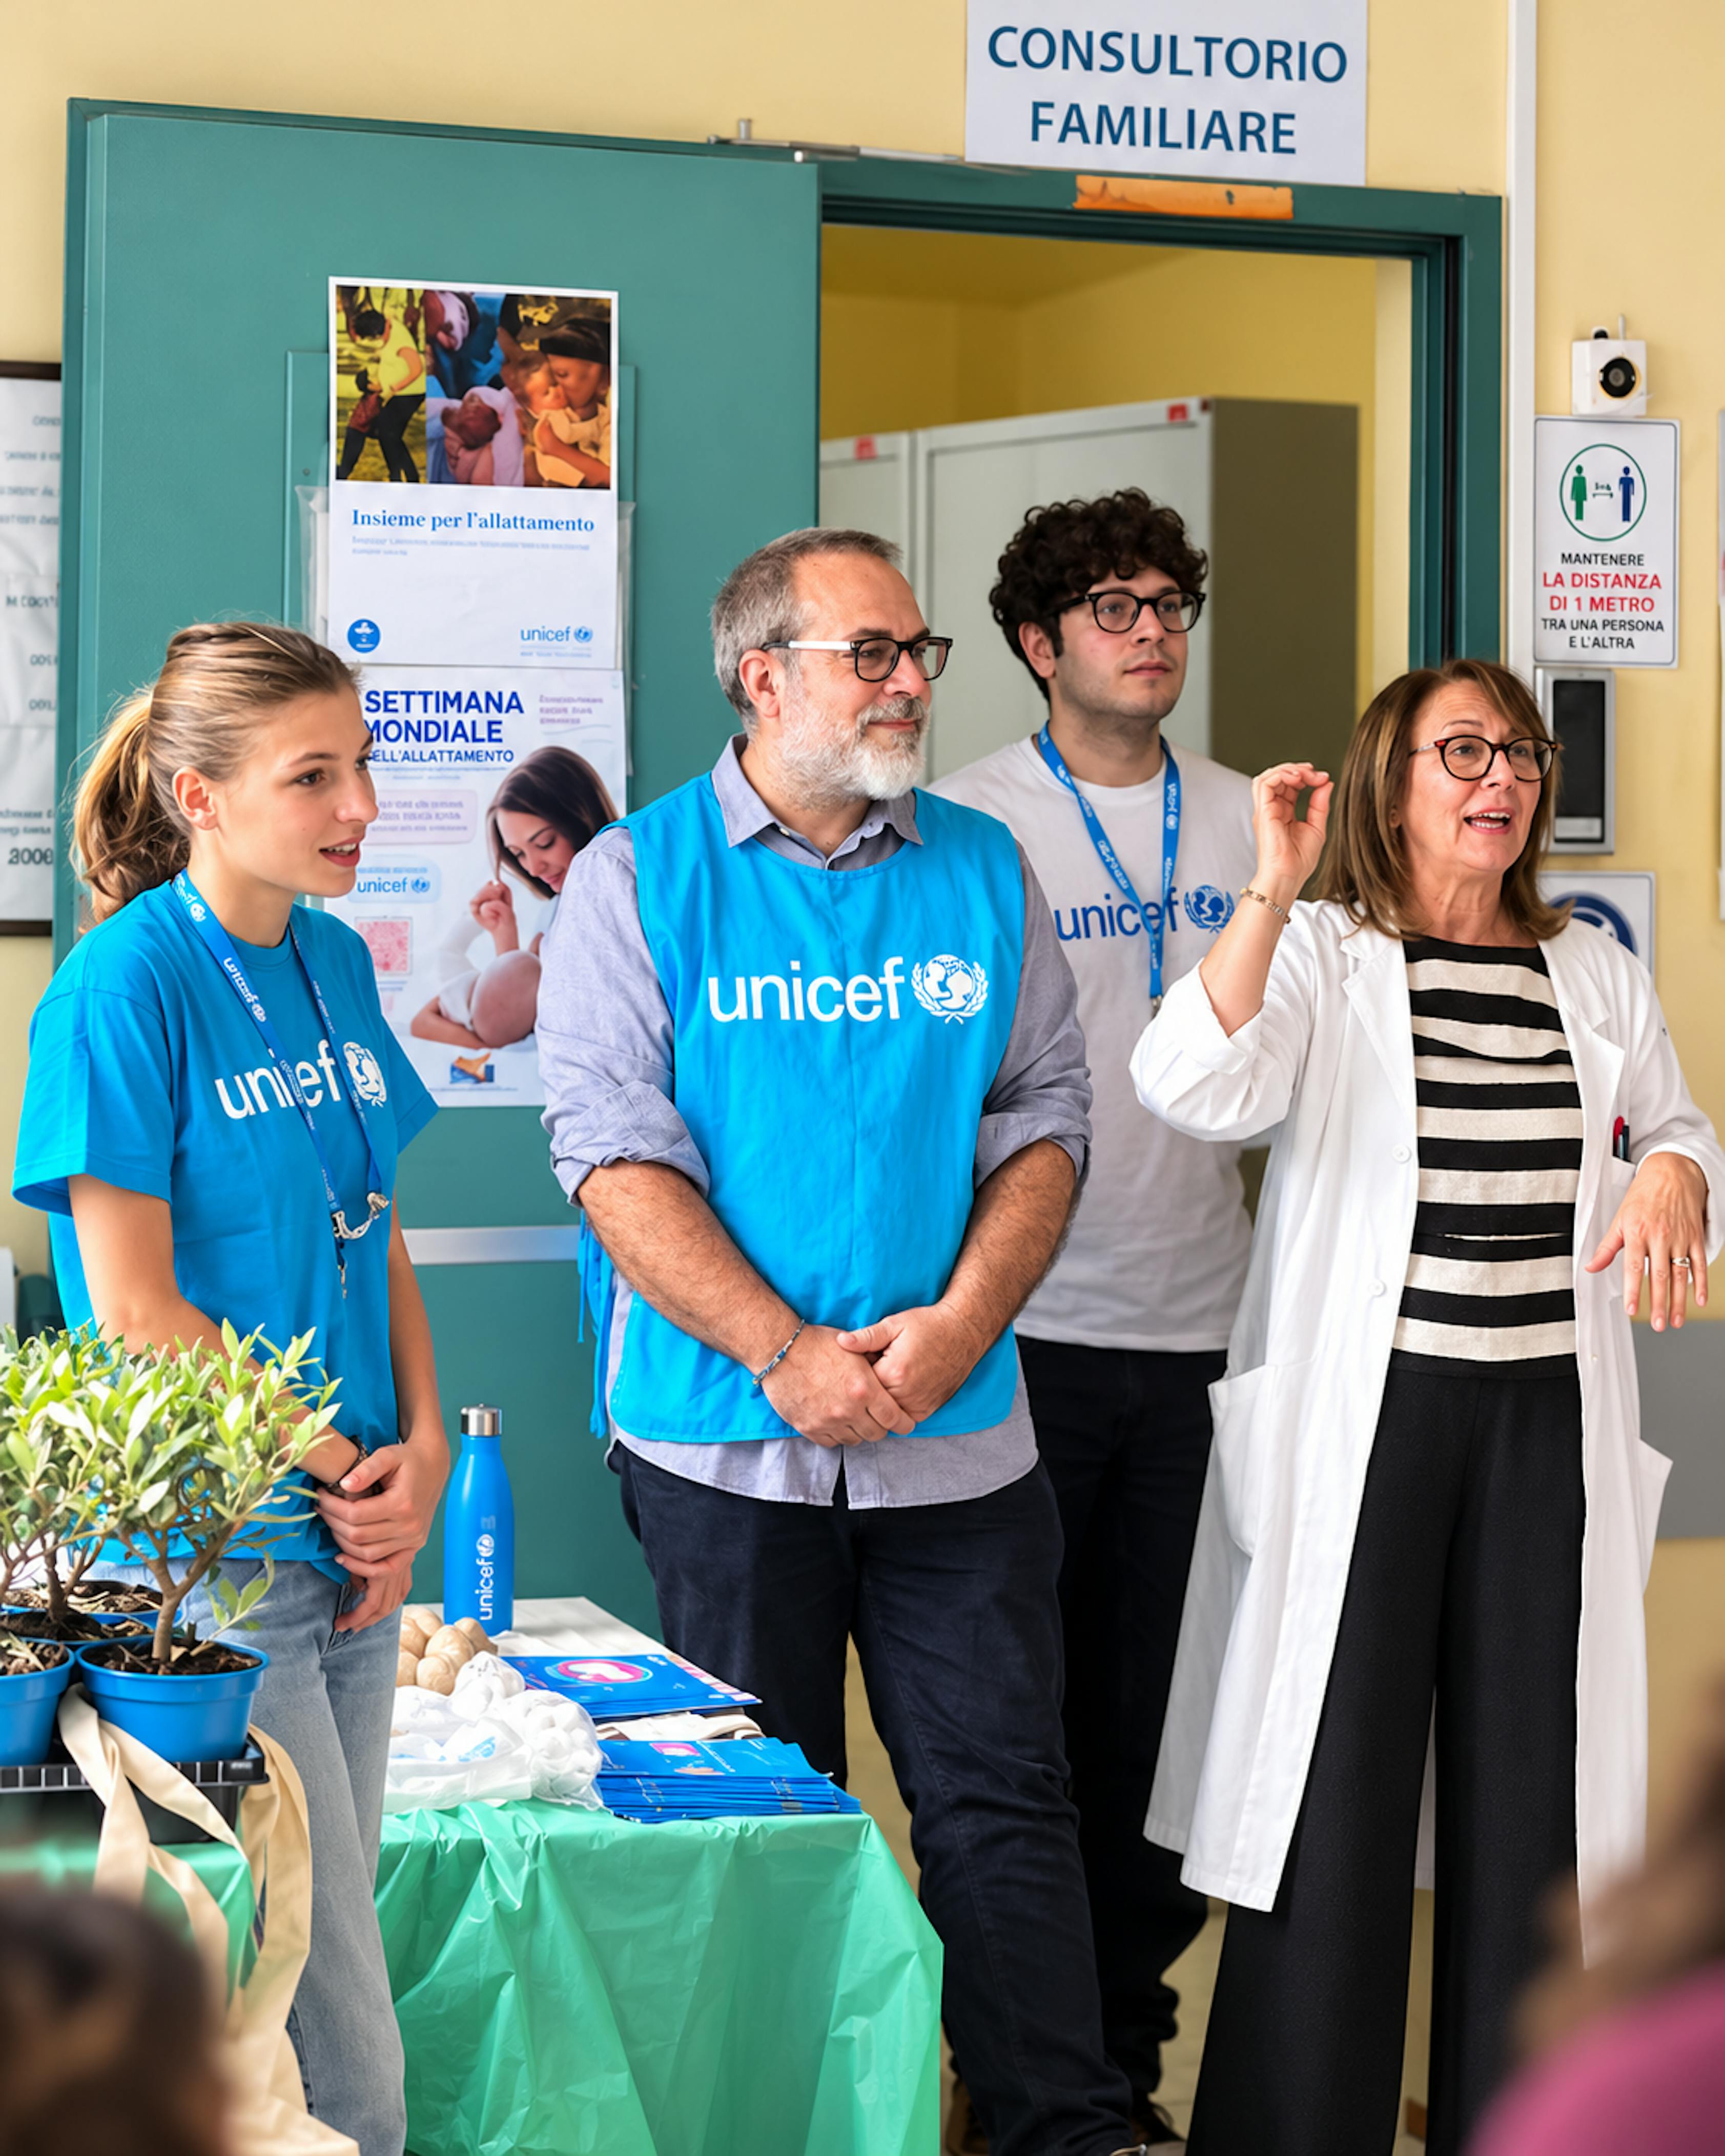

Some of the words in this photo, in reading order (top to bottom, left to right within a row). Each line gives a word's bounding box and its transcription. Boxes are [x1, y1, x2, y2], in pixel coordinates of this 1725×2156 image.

[988, 26, 1347, 83] CONSULTORIO
[1031, 101, 1297, 154] FAMILIARE
[352, 509, 426, 527] Insieme
[432, 514, 462, 532] per
[467, 512, 595, 532] l'allattamento
[1561, 553, 1645, 566] MANTENERE
[1543, 572, 1565, 587] LA
[1571, 573, 1662, 589] DISTANZA
[1550, 595, 1567, 611] DI
[1574, 596, 1582, 612] 1
[1590, 596, 1655, 613] METRO
[520, 625, 570, 642] unicef
[1541, 618, 1567, 630] TRA
[1570, 619, 1598, 631] UNA
[1602, 619, 1665, 632] PERSONA
[1569, 636, 1577, 648] E
[1581, 636, 1635, 649] L'ALTRA
[365, 690, 524, 714] SETTIMANA
[372, 749, 514, 763] ELL'ALLATTAMENTO
[357, 877, 407, 893] unicef
[1054, 886, 1179, 941] unicef
[707, 955, 905, 1023] unicef
[214, 1039, 341, 1120] unief
[475, 1557, 494, 1620] unicef
